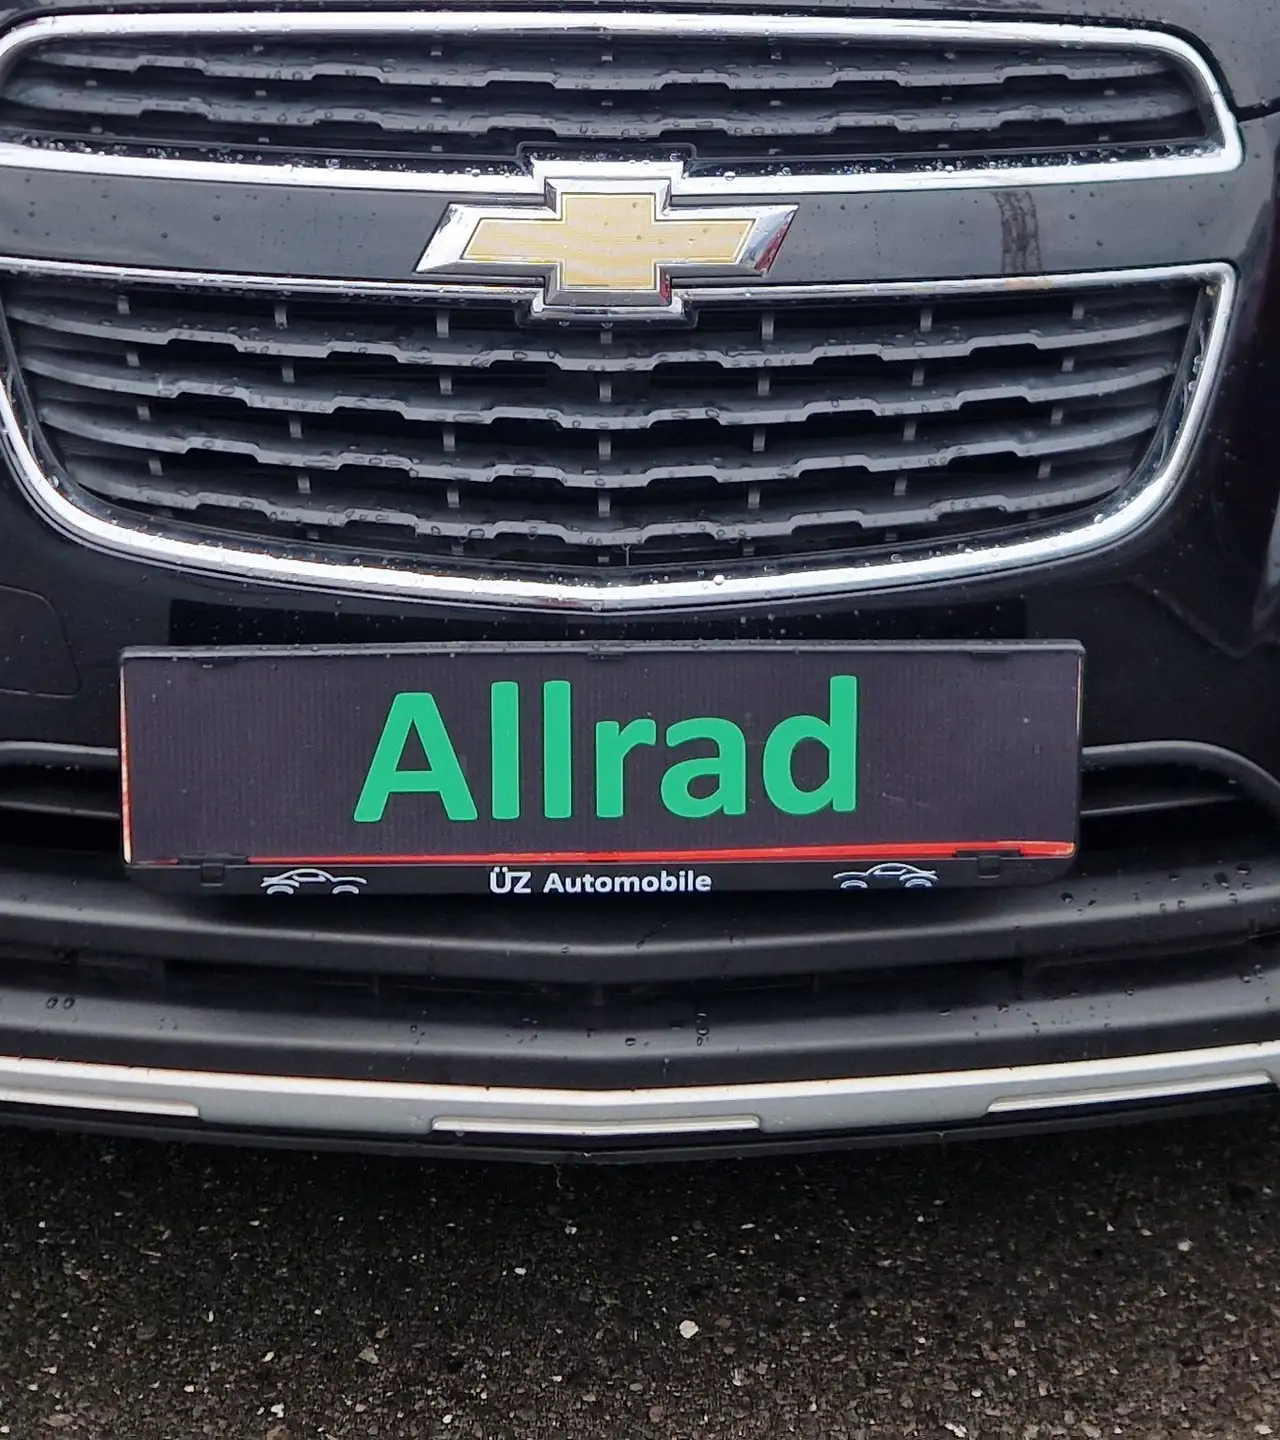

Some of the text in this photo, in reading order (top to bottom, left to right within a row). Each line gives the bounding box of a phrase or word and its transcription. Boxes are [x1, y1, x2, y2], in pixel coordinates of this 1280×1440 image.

[352, 674, 858, 824] Allrad
[489, 866, 713, 894] ÜZ Automobile
